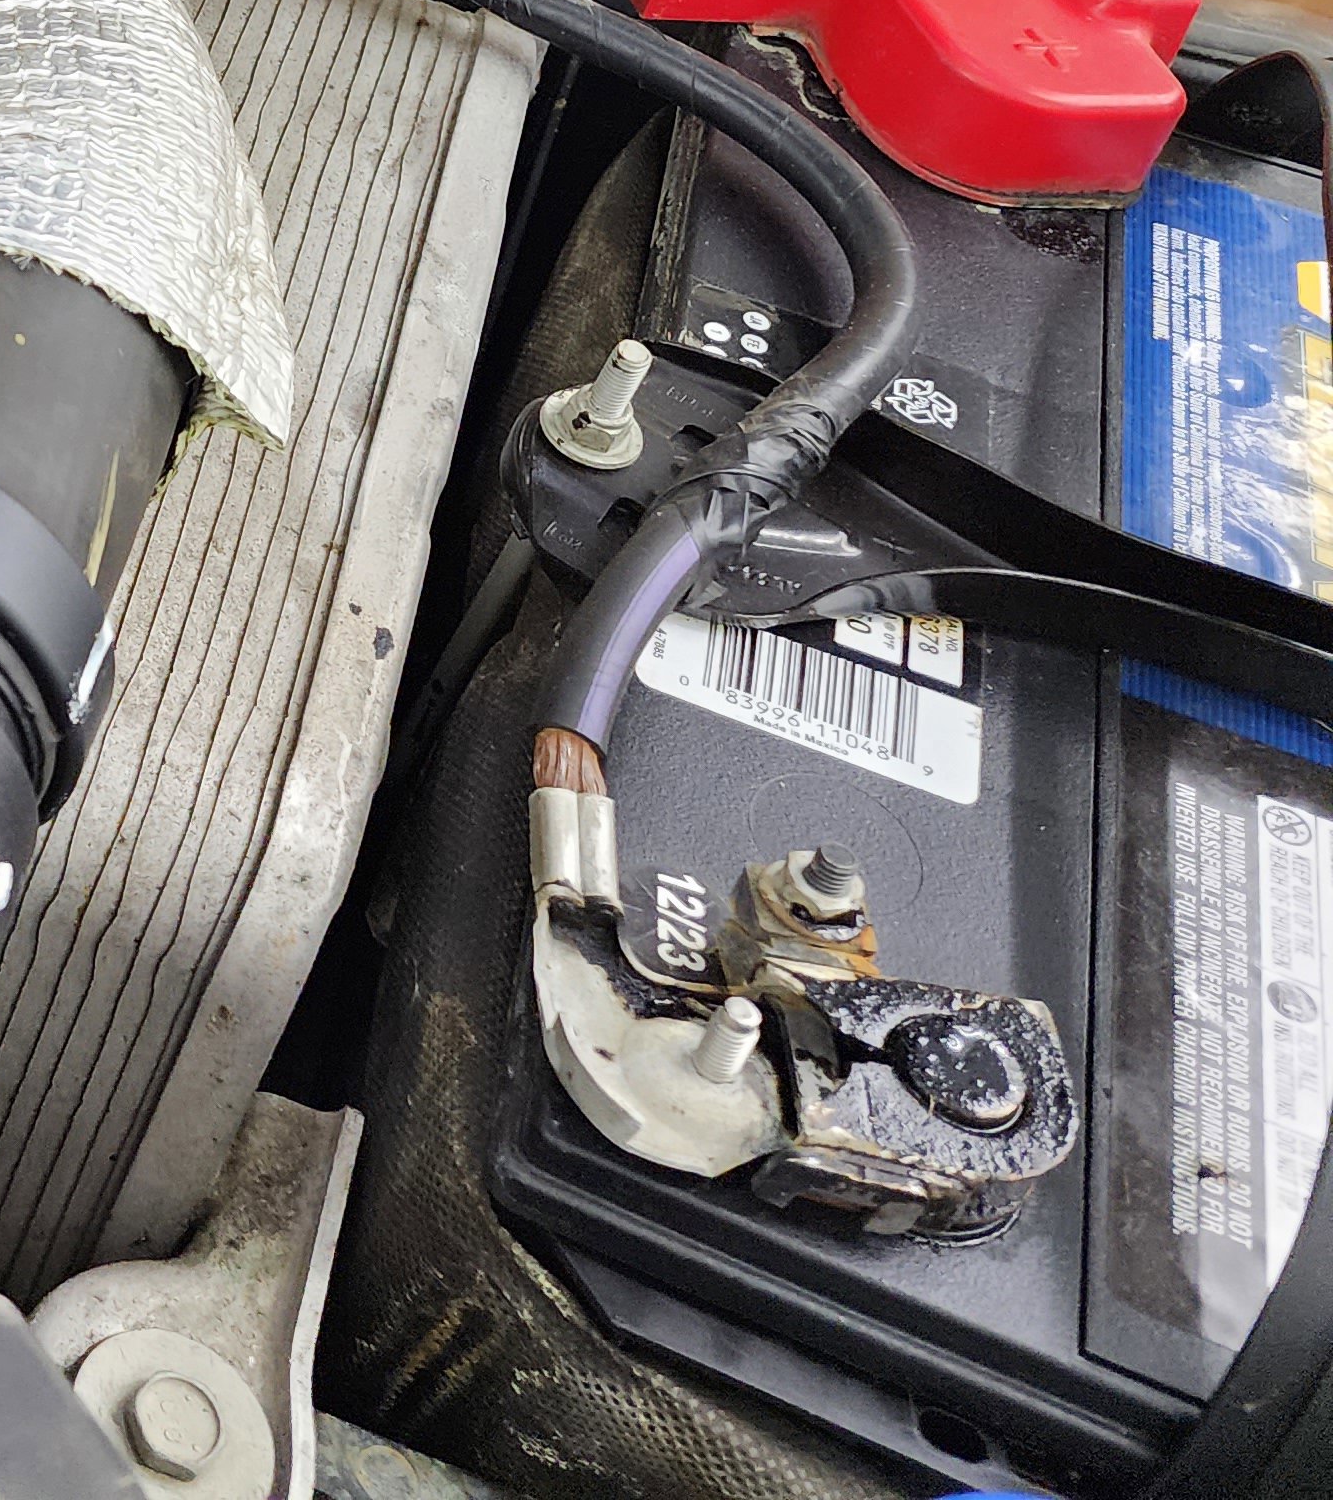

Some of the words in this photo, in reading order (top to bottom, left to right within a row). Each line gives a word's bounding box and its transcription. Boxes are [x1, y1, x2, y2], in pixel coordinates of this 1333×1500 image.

[1151, 222, 1167, 247] WASH
[1151, 243, 1168, 273] HANDS
[1152, 272, 1168, 297] AFTER
[1189, 424, 1206, 468] California
[1172, 488, 1189, 533] California
[679, 674, 690, 687] 0
[725, 688, 801, 728] 83996
[817, 723, 893, 761] 11048
[922, 764, 934, 777] 9
[753, 714, 787, 734] Made
[790, 728, 801, 740] in
[804, 733, 849, 757] Mexico
[1174, 782, 1196, 852] INVERTED
[1199, 804, 1221, 907] DISASSEMBLE
[1223, 813, 1246, 886] WARNING:
[1269, 844, 1289, 885] REACH
[1292, 852, 1311, 885] KEEP
[1224, 887, 1246, 924] RISK
[1270, 886, 1290, 907] OF
[1293, 885, 1313, 915] OUT
[657, 873, 706, 970] 12/23
[1173, 889, 1196, 957] FOLLOW
[1200, 906, 1221, 930] OR
[1225, 925, 1246, 951] OF
[1270, 906, 1292, 968] CHILDREN
[1294, 915, 1314, 935] OF
[1293, 935, 1314, 959] THE
[1173, 953, 1197, 1019] PROPER
[1223, 949, 1247, 987] FIRE,
[1200, 1027, 1222, 1066] NOT
[1225, 992, 1249, 1084] EXPLOSION
[1173, 1020, 1196, 1106] CHARGING
[1226, 1084, 1250, 1111] OR
[1199, 1064, 1224, 1195] RECOMMENDD
[1226, 1111, 1250, 1174] BURNS.
[1171, 1105, 1198, 1235] INSTRUCTIONS.
[1199, 1196, 1224, 1235] FOR
[1227, 1182, 1251, 1209] DO
[1228, 1208, 1252, 1250] NOT
